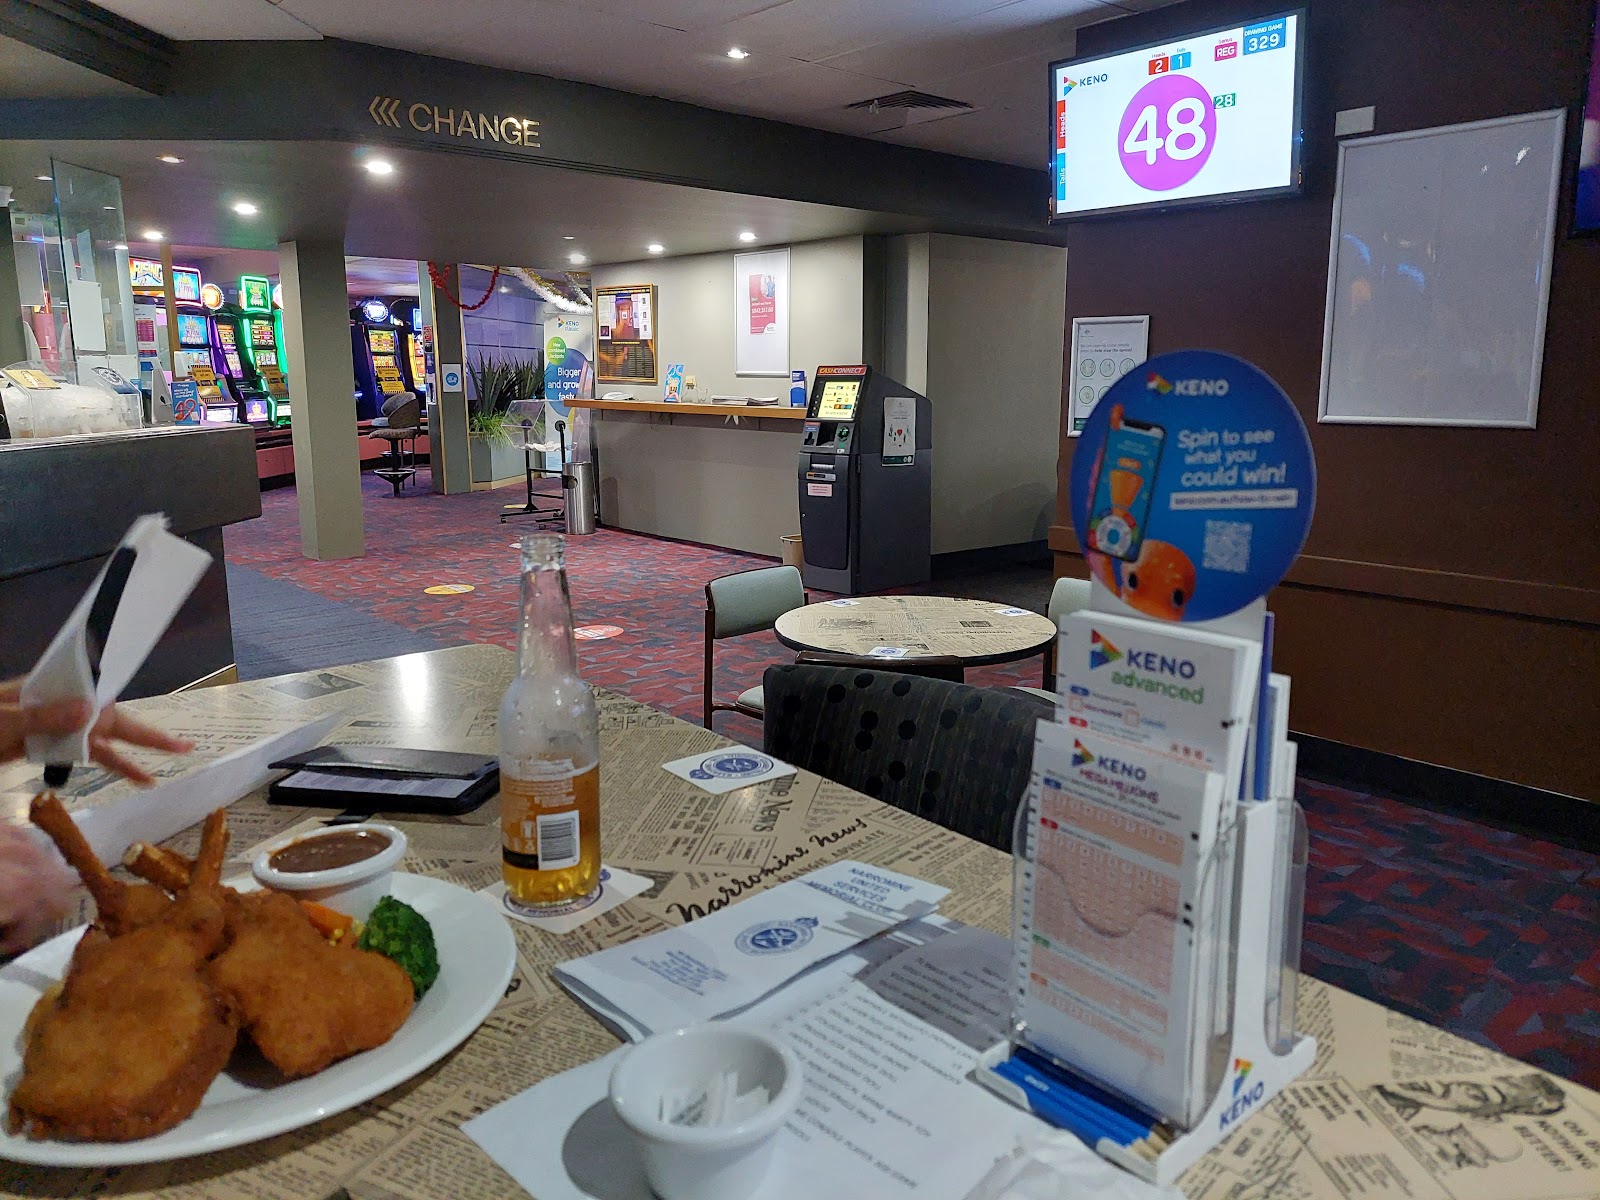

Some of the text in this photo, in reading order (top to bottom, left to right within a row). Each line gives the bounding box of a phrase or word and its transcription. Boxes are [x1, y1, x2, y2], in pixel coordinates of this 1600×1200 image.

[1267, 23, 1283, 32] GAME
[1248, 33, 1279, 51] 329
[1216, 45, 1235, 58] REG
[1155, 60, 1163, 74] 2
[1178, 56, 1183, 68] 1
[1079, 73, 1108, 87] KENO
[1215, 93, 1233, 109] 28
[408, 102, 541, 148] CHANGE
[1123, 97, 1207, 165] 48
[557, 368, 582, 378] Bigger
[547, 380, 561, 389] and
[1174, 379, 1230, 396] KENO
[1177, 429, 1276, 449] Spin to see
[1184, 449, 1257, 466] what you
[1180, 462, 1288, 487] could win!
[1127, 648, 1196, 679] KENO
[1111, 670, 1205, 705] advanced
[1097, 755, 1147, 781] KENO
[1219, 1081, 1265, 1131] KENO
